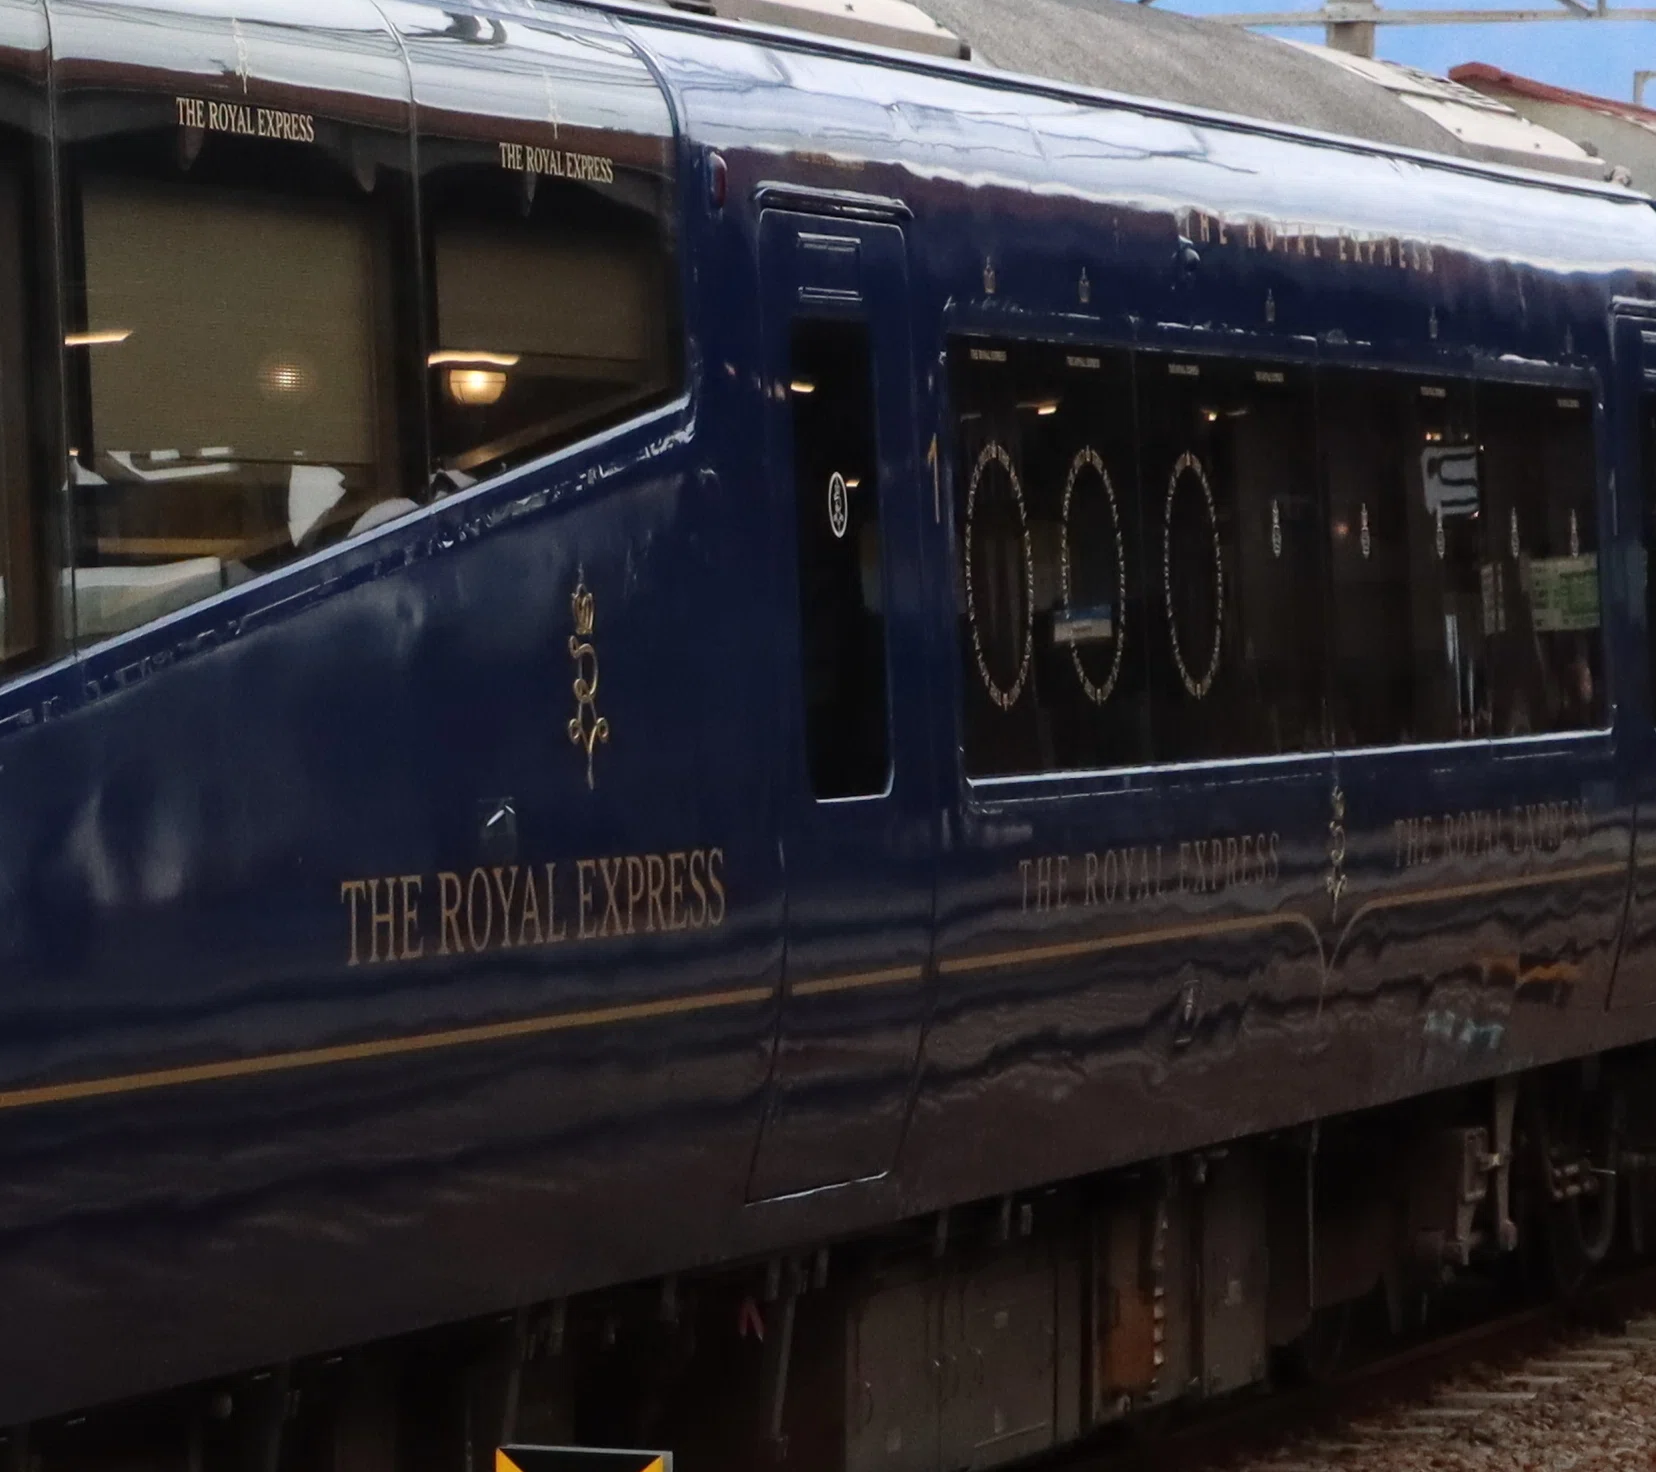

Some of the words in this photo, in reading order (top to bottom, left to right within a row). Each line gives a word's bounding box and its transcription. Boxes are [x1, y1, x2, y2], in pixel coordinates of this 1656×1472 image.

[175, 96, 206, 128] THE
[208, 101, 256, 135] ROYAL
[256, 108, 315, 143] EXPRESS
[498, 141, 524, 171] THE
[526, 145, 565, 176] ROYAL
[565, 152, 614, 184] EXPRESS
[1393, 817, 1433, 869] THE
[1440, 808, 1502, 860] ROYAL
[1510, 798, 1589, 855] EXPRESS
[340, 874, 425, 967] THE
[437, 862, 567, 956] ROYAL
[575, 846, 727, 940] EXPRESS
[1018, 856, 1072, 914] THE
[1083, 846, 1168, 908] ROYAL
[1178, 829, 1282, 896] EXPRESS
